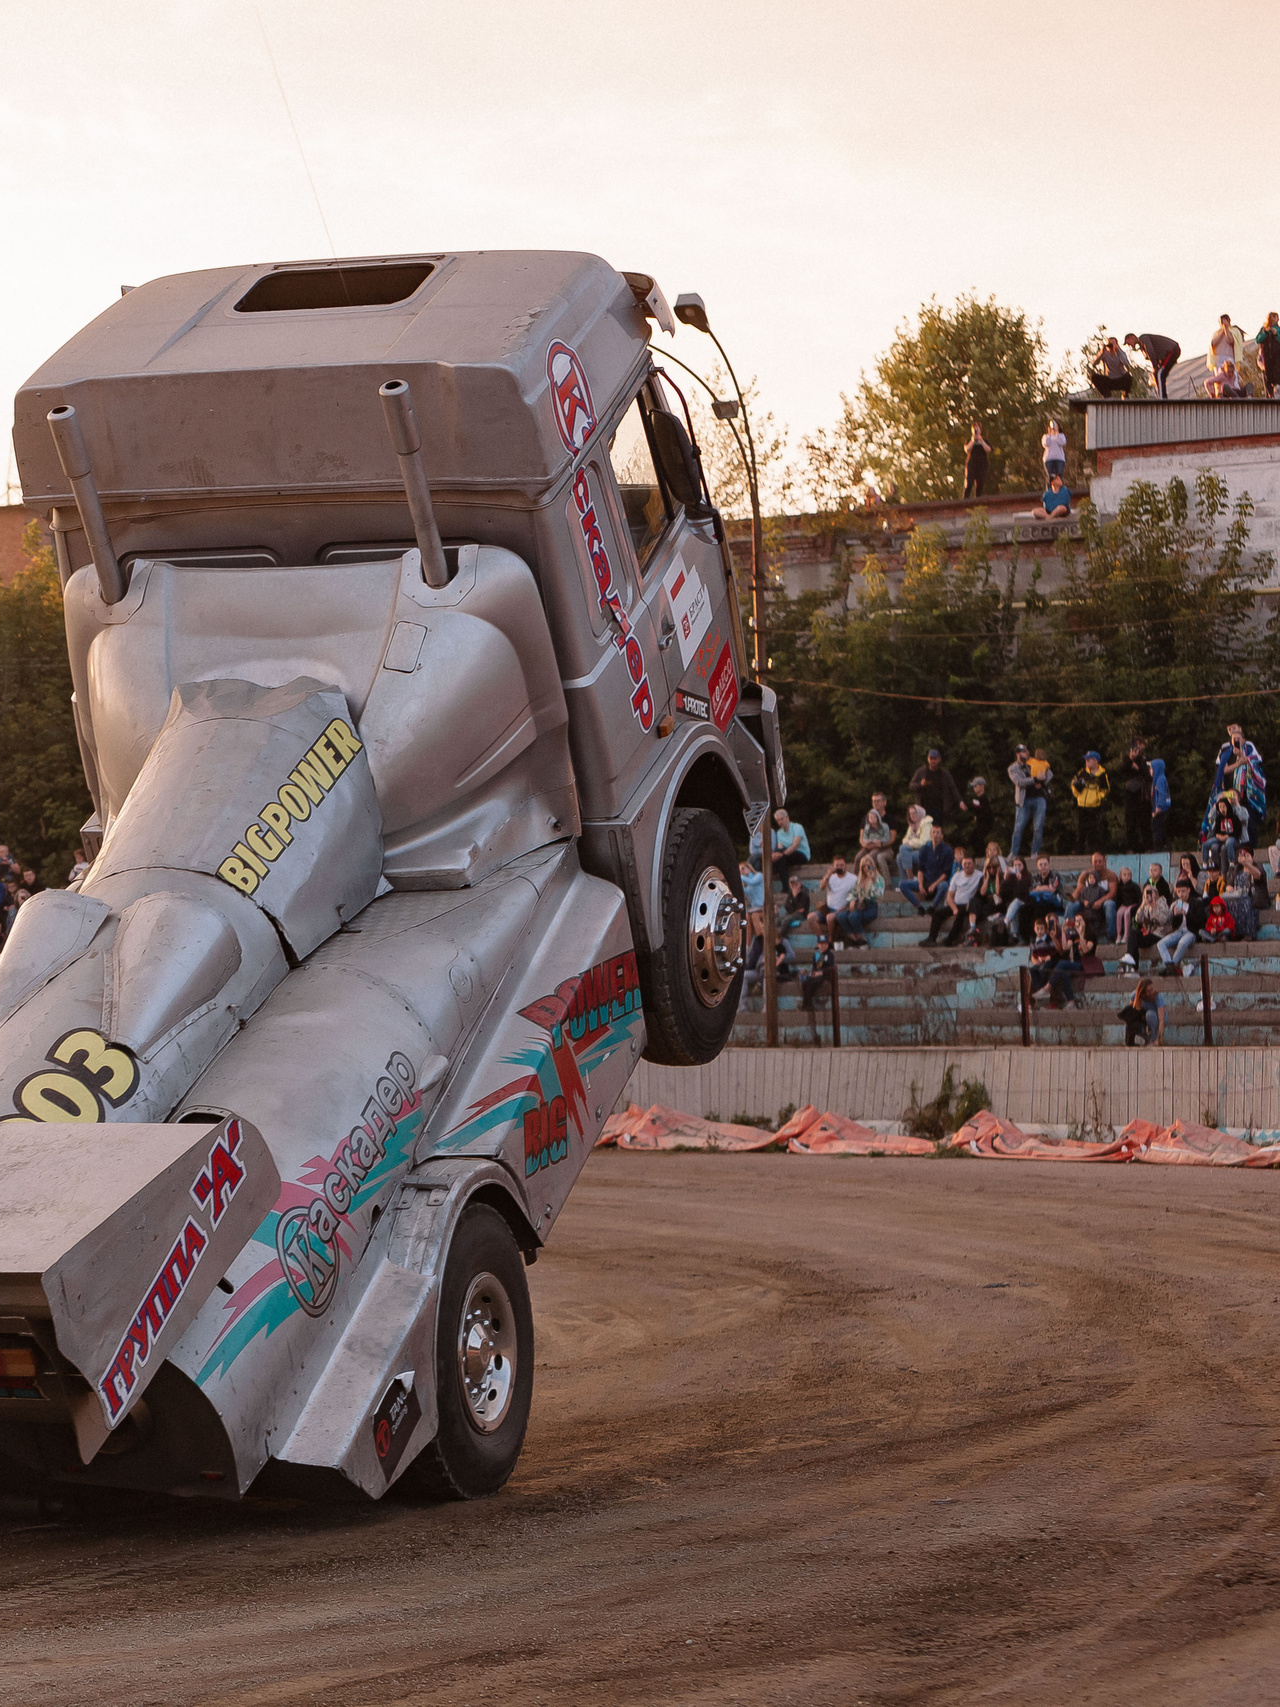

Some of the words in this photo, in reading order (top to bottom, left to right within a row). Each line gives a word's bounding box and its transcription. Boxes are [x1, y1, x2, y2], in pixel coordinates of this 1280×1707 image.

[216, 718, 364, 896] BIGPOWER
[517, 950, 642, 1051] POWER
[276, 1051, 415, 1317] Каскадер
[523, 1094, 568, 1179] BIG
[98, 1214, 209, 1429] ГРУППА
